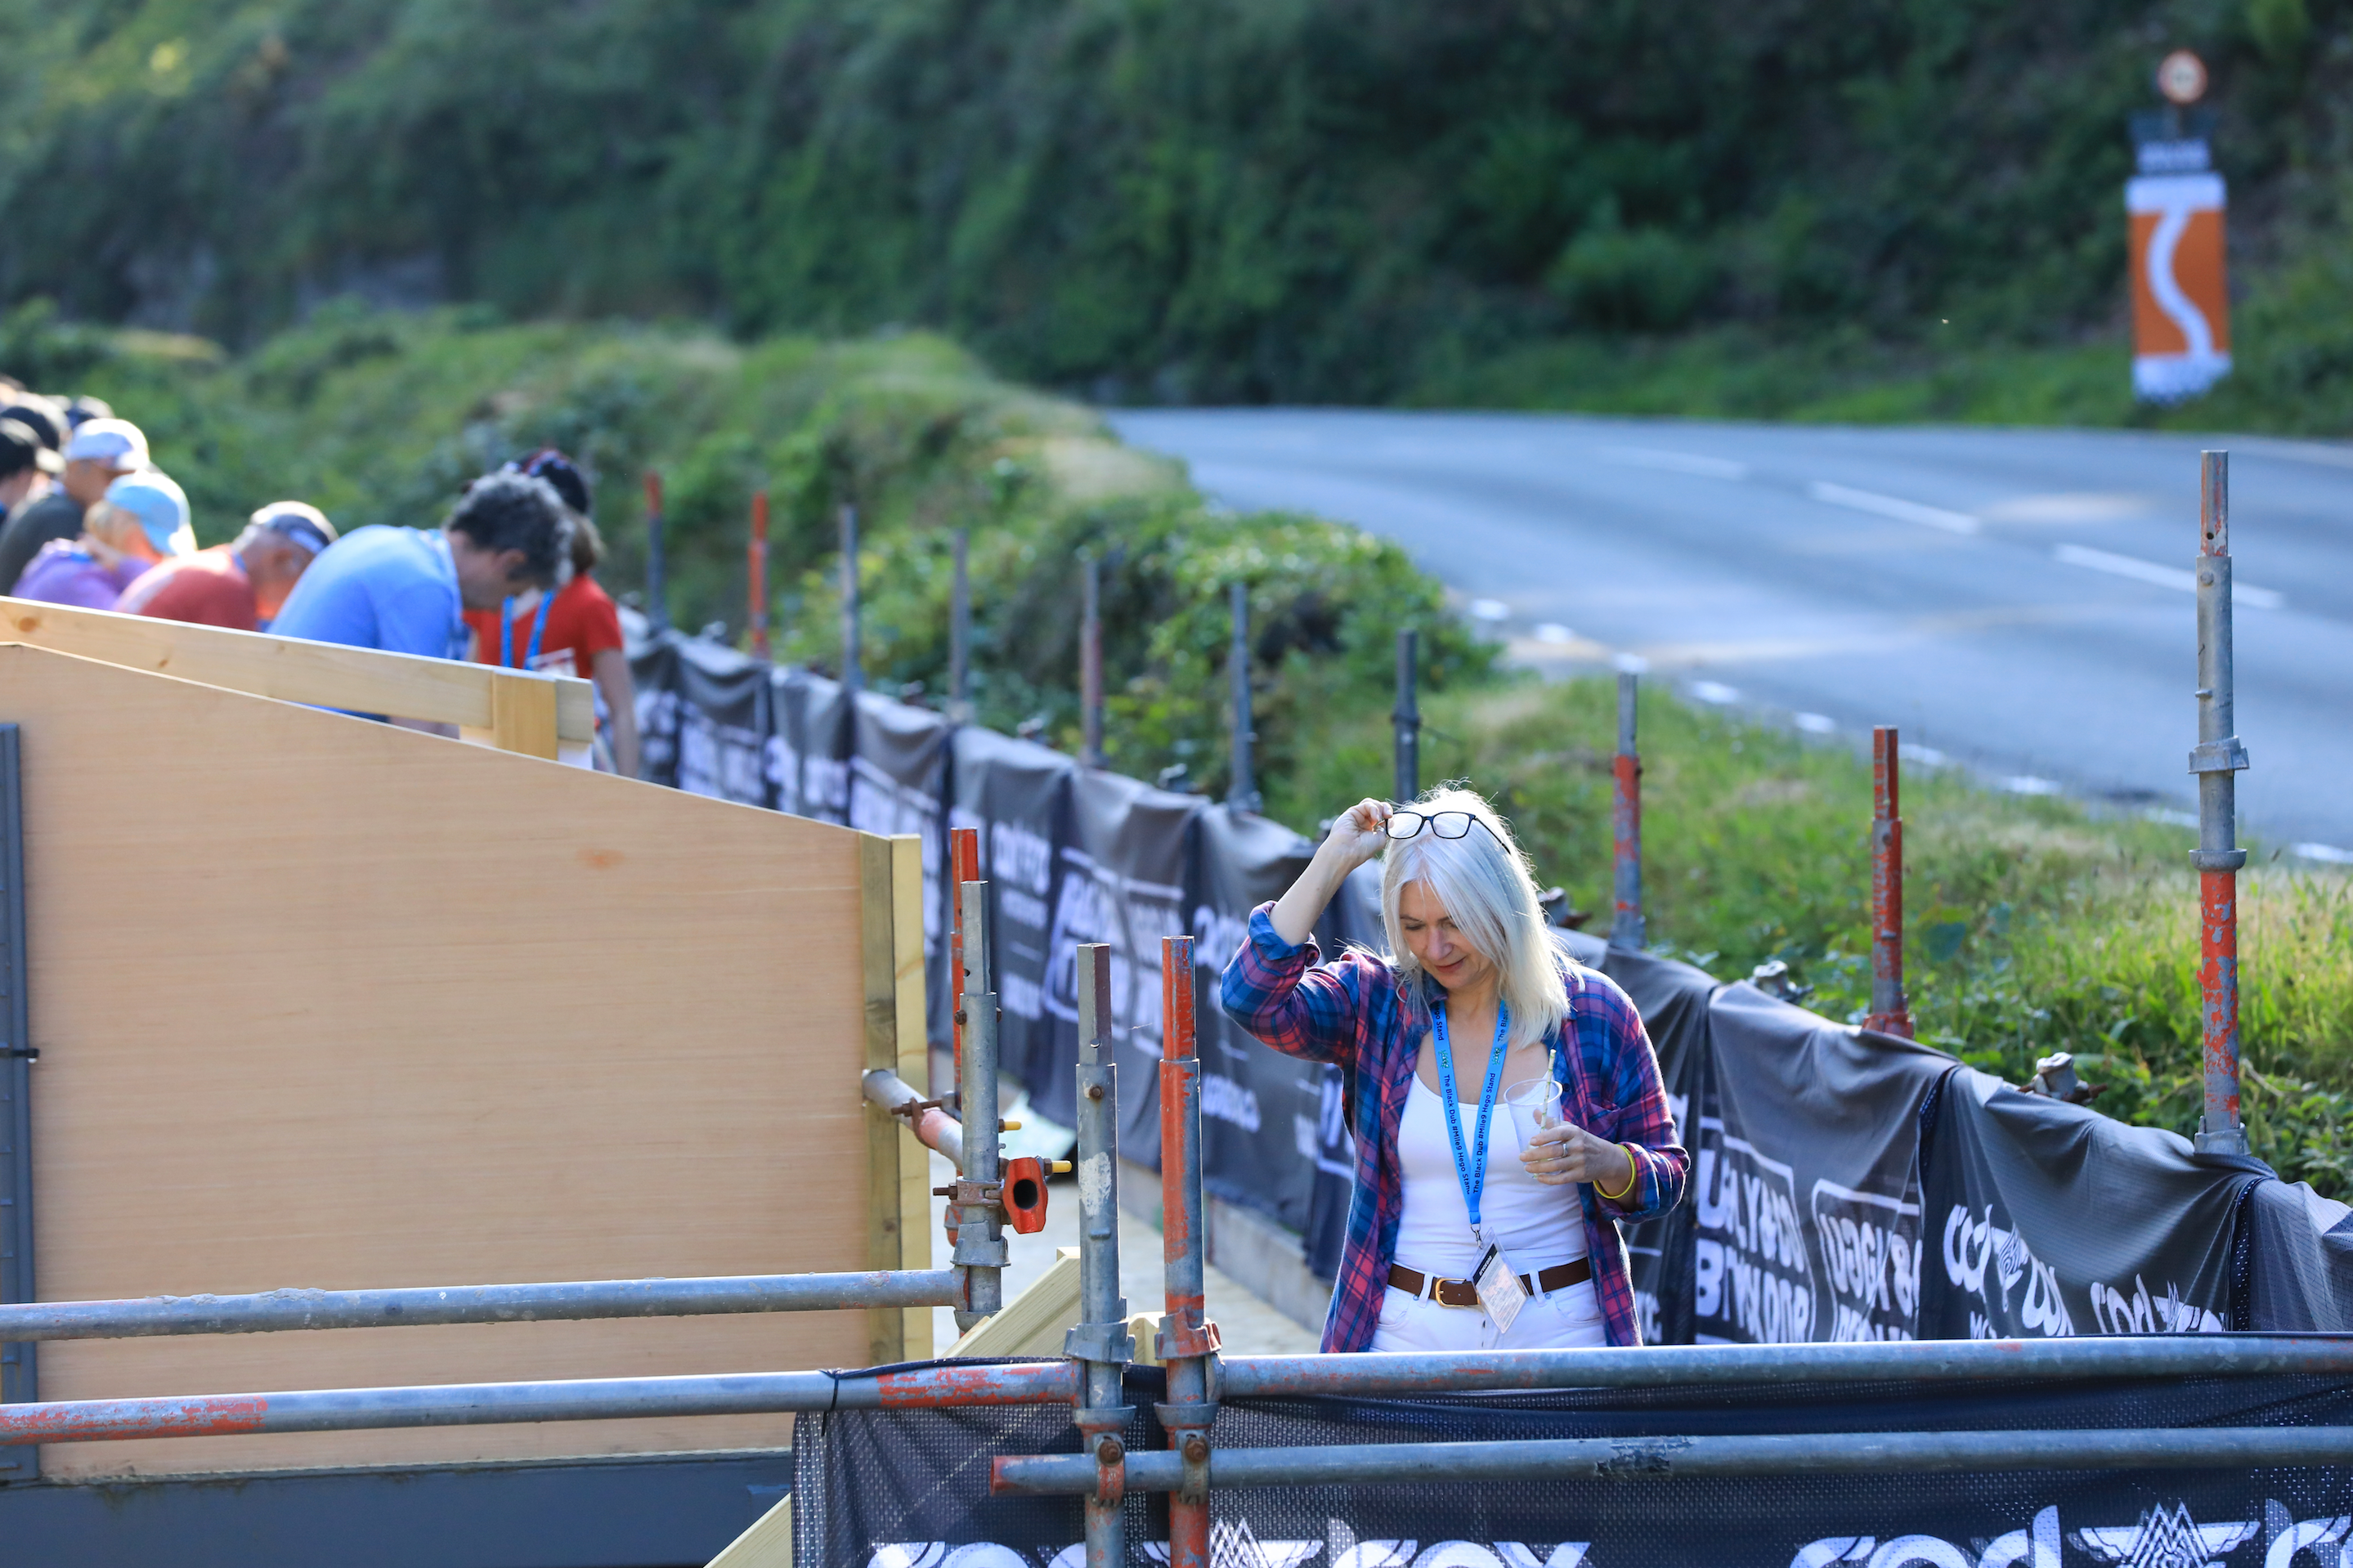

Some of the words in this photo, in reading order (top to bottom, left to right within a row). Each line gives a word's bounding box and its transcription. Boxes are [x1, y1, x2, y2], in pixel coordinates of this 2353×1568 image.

[1498, 1029, 1506, 1042] The
[1486, 1073, 1495, 1093] Stand
[1445, 1088, 1455, 1108] Black
[1481, 1094, 1491, 1113] Hego
[1449, 1109, 1457, 1124] Dub
[1478, 1114, 1487, 1140] #Mile9
[1452, 1126, 1463, 1150] #Mile9
[1458, 1152, 1466, 1172] Hego
[1474, 1158, 1482, 1178] Black
